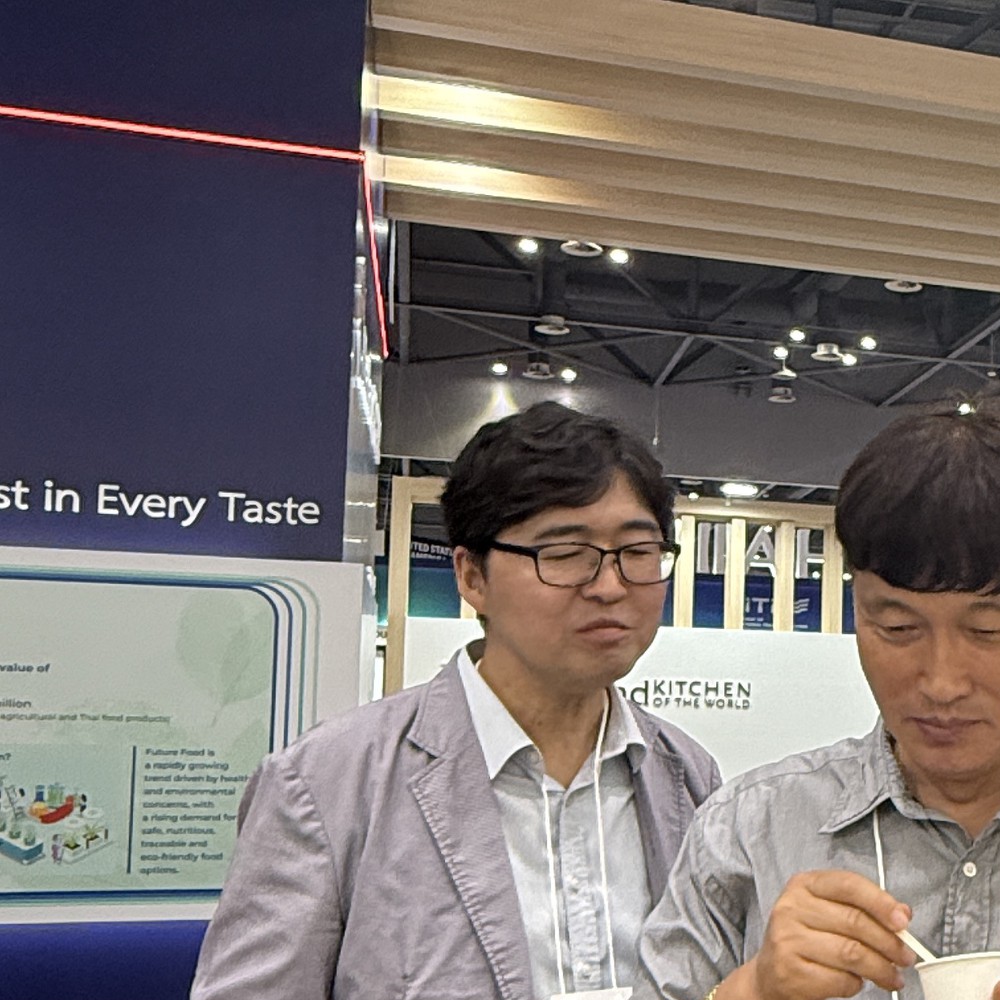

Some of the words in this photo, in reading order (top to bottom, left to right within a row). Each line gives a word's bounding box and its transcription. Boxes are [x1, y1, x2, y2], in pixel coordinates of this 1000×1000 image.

[44, 480, 80, 513] in
[97, 484, 206, 527] Every
[218, 491, 320, 525] Taste
[37, 663, 50, 673] of
[653, 679, 751, 698] KITCHEN
[653, 697, 671, 708] OF
[674, 698, 700, 709] THE
[704, 698, 751, 711] WORLD
[188, 762, 229, 771] growing
[206, 775, 219, 784] by
[151, 814, 178, 823] rising
[180, 814, 221, 822] demand
[223, 813, 236, 821] for
[140, 853, 199, 862] eco-friendly
[201, 852, 223, 860] food
